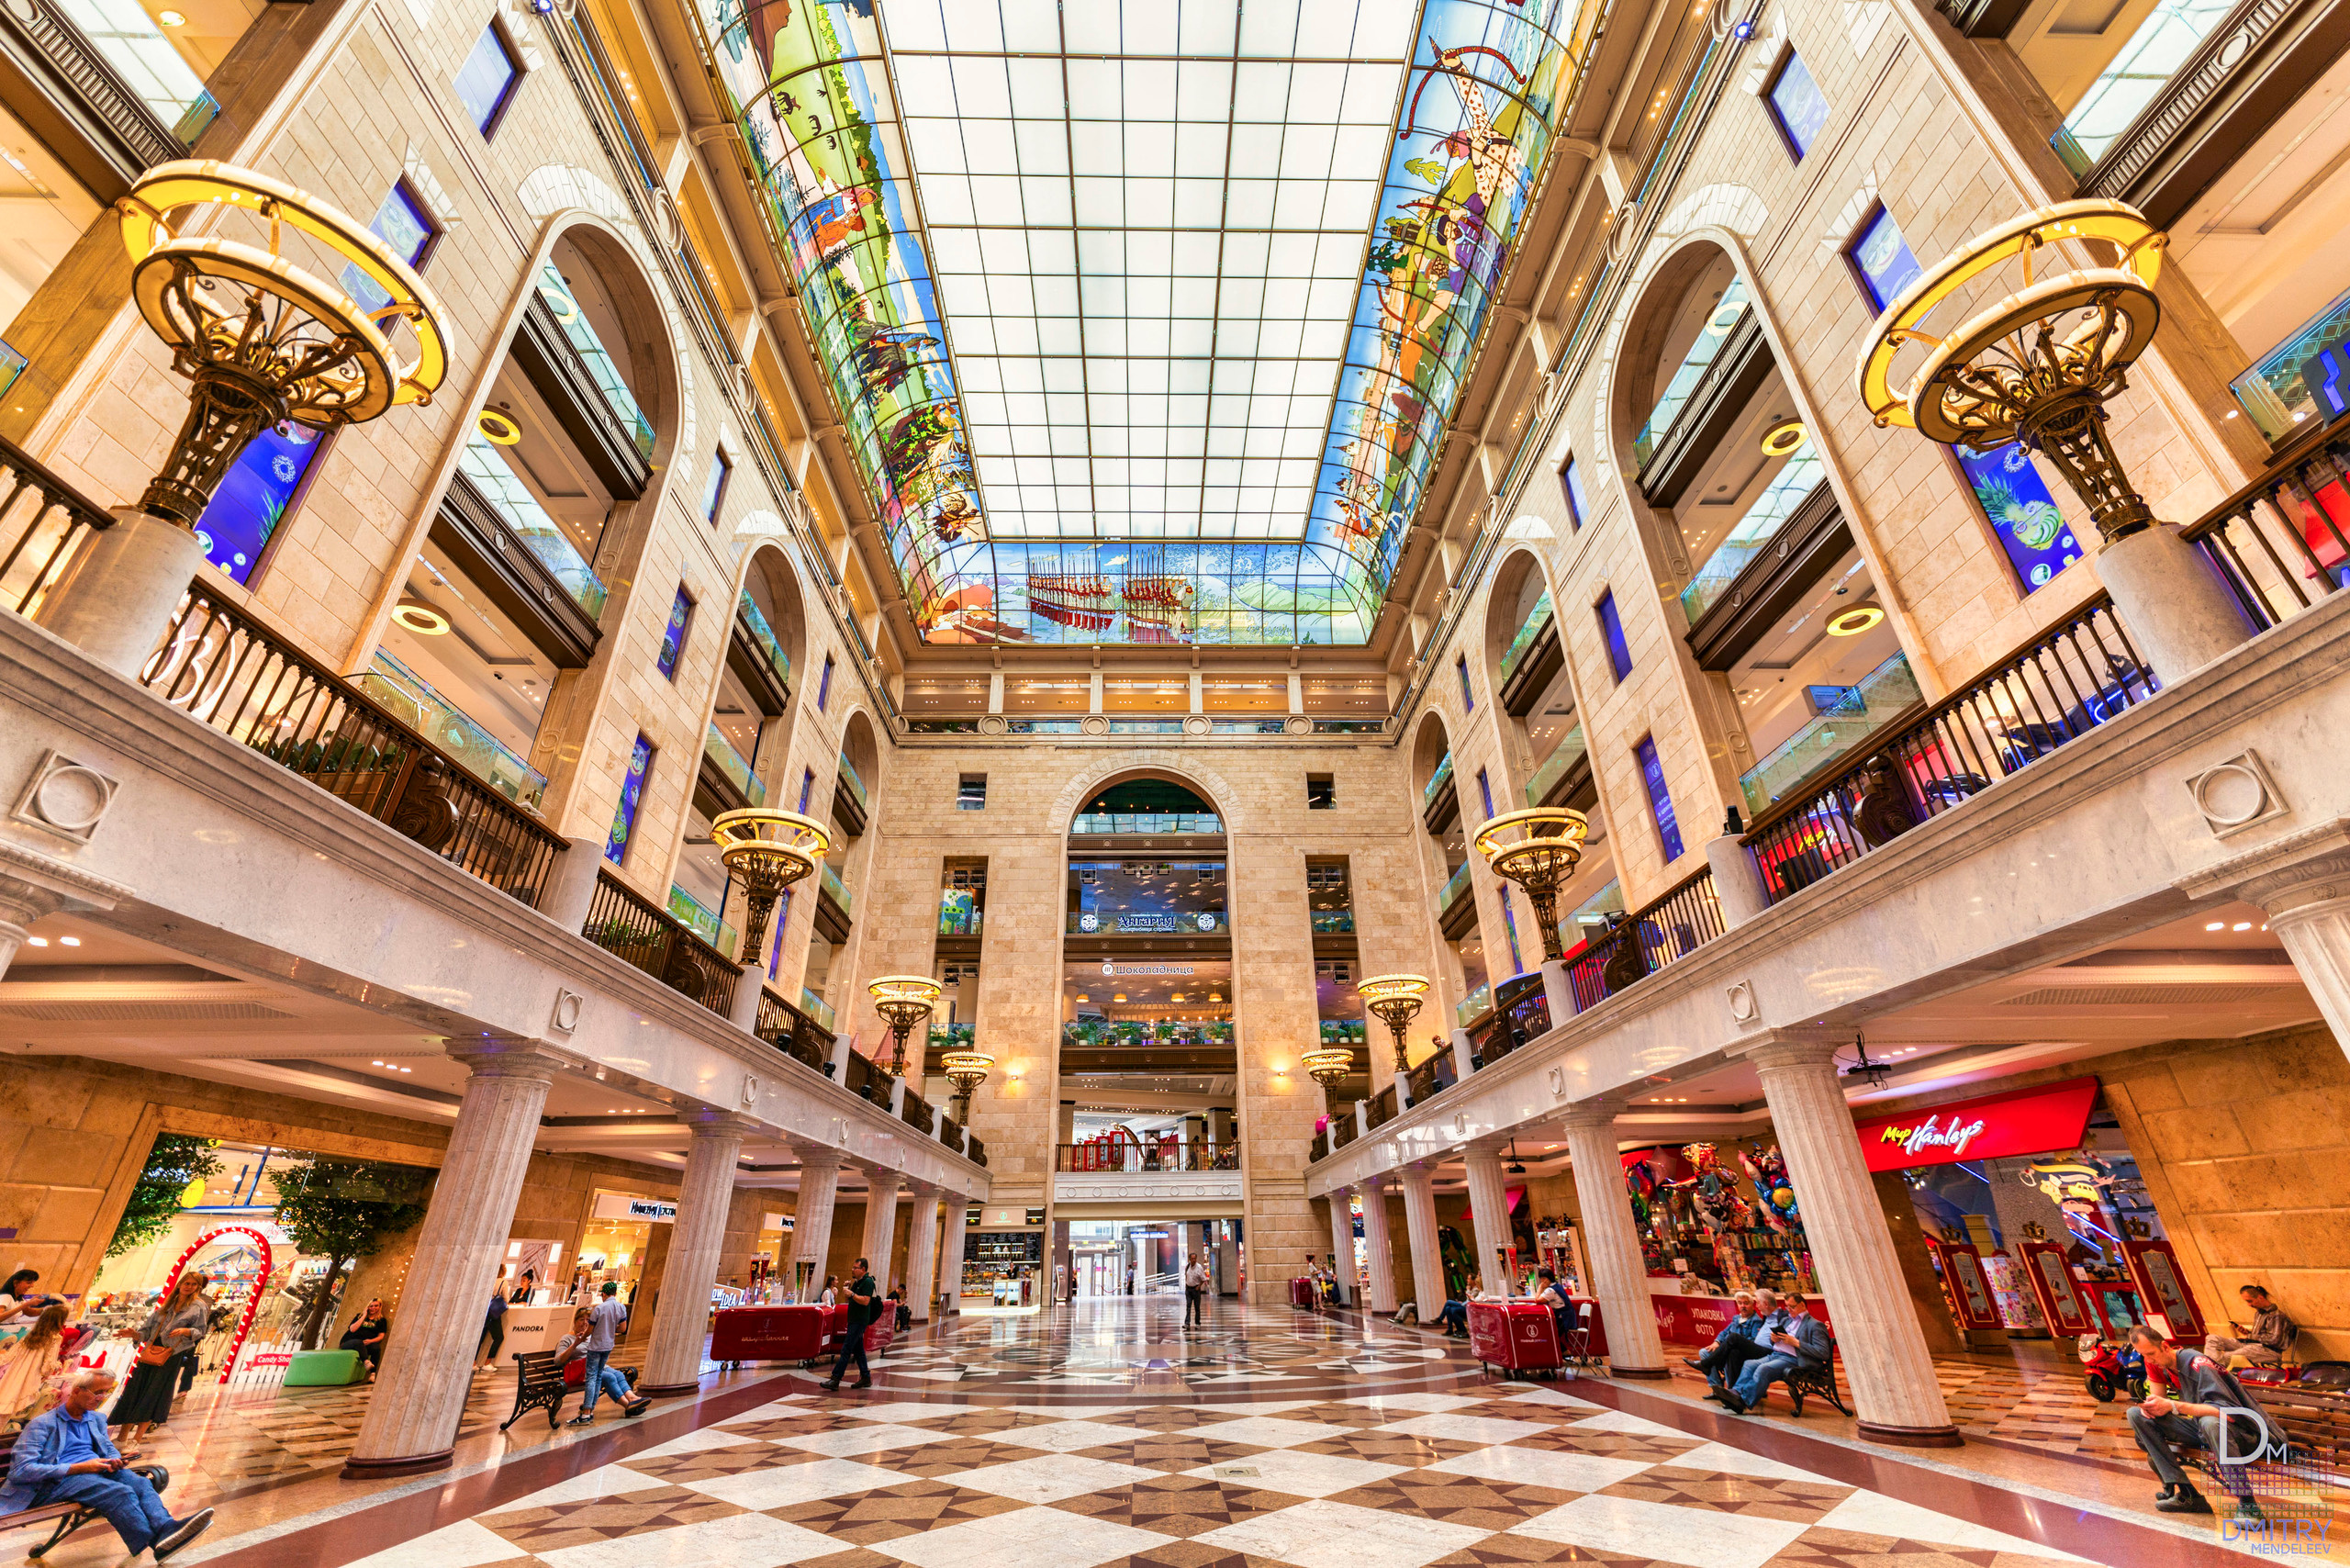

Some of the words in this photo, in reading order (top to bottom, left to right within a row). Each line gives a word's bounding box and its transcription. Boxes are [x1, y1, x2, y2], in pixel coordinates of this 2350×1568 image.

[1115, 965, 1194, 975] Шоколадница
[1903, 1114, 1983, 1154] Hamleys
[711, 1289, 724, 1298] OW
[720, 1293, 737, 1306] IDEA
[1691, 1307, 1726, 1322] УПАКОВКА
[1695, 1325, 1715, 1337] ФОТО
[257, 1355, 277, 1364] Candy
